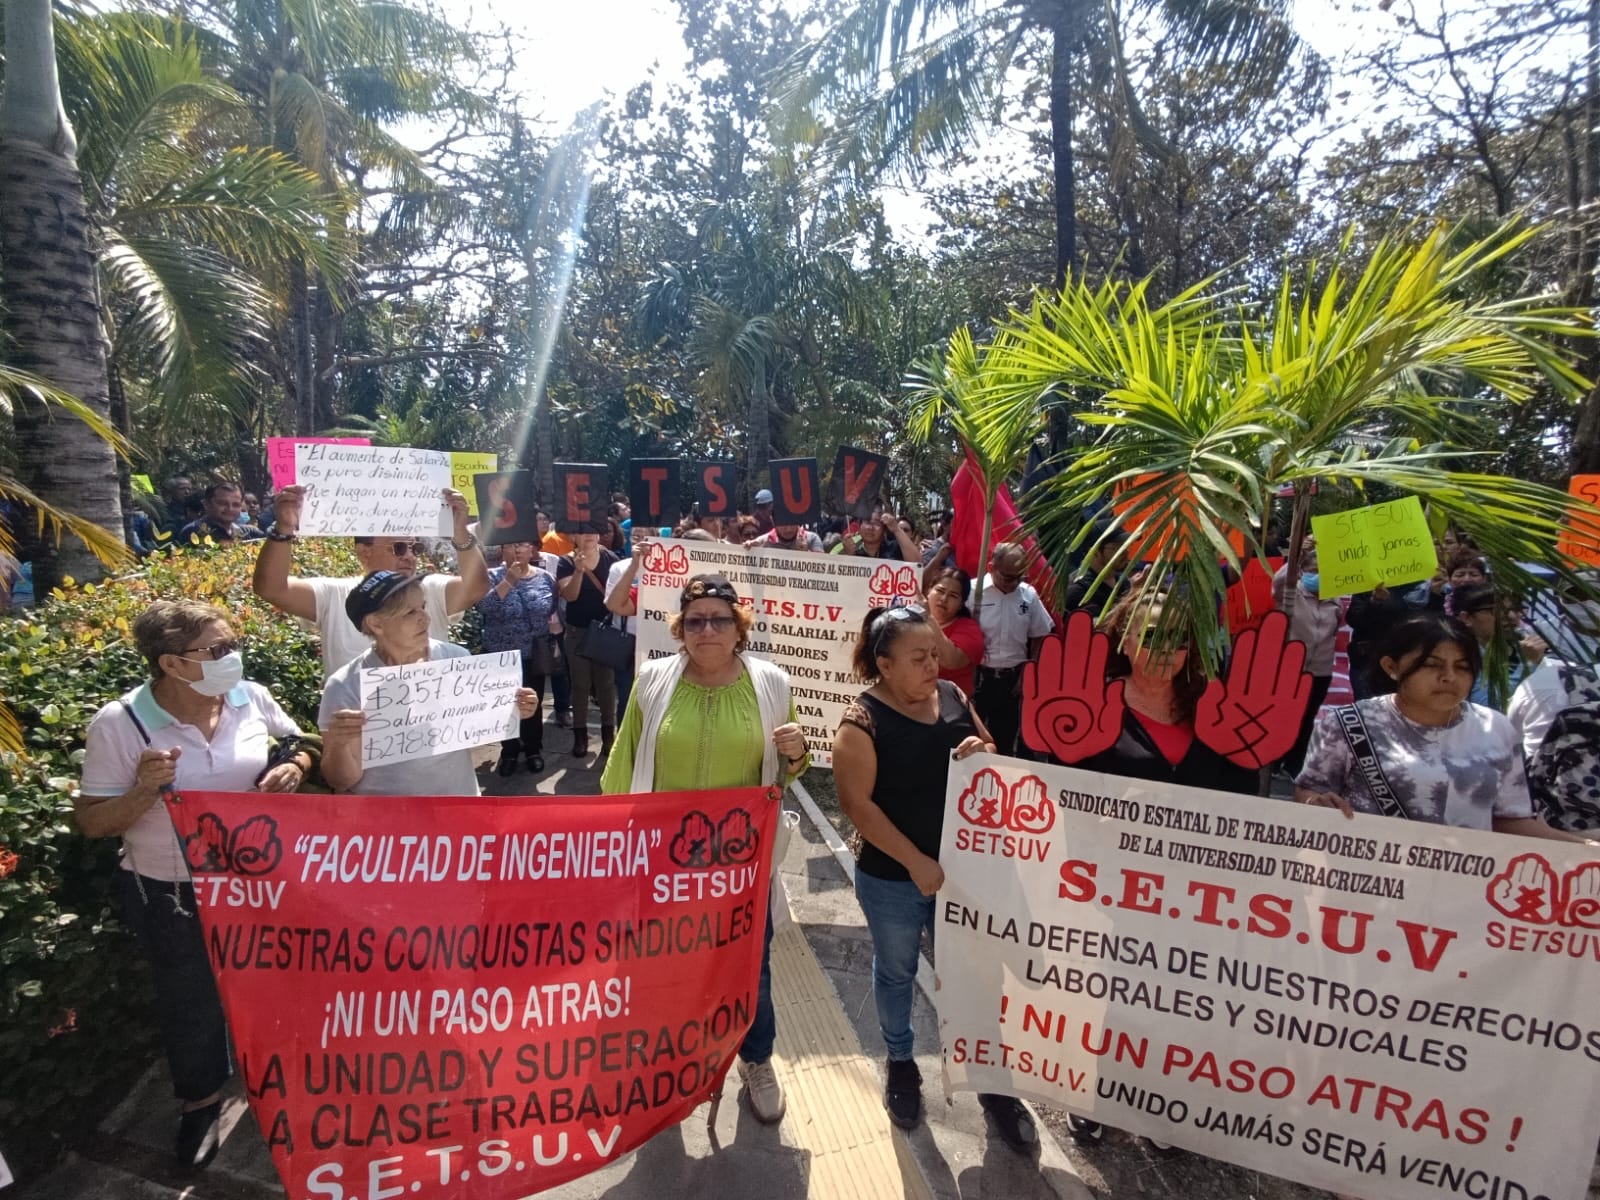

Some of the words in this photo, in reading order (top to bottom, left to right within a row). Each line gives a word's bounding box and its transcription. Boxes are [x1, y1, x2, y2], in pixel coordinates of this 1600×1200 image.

[324, 467, 362, 481] puro
[368, 464, 429, 481] disimulo
[328, 448, 385, 464] aumento
[389, 449, 404, 465] de
[335, 483, 376, 502] hagan
[381, 488, 399, 498] un
[689, 550, 727, 563] SINDICATO
[728, 554, 758, 567] ESTATAL
[759, 557, 769, 569] DE
[771, 557, 826, 574] TRABAJADORES
[827, 563, 837, 575] AL
[837, 564, 872, 578] SERVICIO
[1338, 539, 1370, 563] unido
[729, 571, 739, 582] LA
[739, 573, 787, 588] UNIVERSIDAD
[787, 576, 839, 592] VERACRUZANA
[744, 640, 829, 661] RABAJADORES
[771, 623, 838, 641] SALARIAL
[363, 665, 436, 684] Salario
[824, 670, 833, 681] Y
[362, 707, 438, 733] Salario
[491, 693, 518, 709] 202
[801, 724, 828, 738] ERÁ
[1359, 755, 1396, 810] BIMBA
[955, 828, 1051, 863] SETSUV
[1058, 788, 1140, 823] SINDICATO
[1142, 804, 1211, 836] ESTATAL
[1214, 816, 1240, 839] DE
[1243, 820, 1378, 863] TRABAJADORES
[1378, 842, 1402, 865] AL
[1406, 845, 1497, 879] SERVICIO
[457, 834, 496, 882] DE
[1118, 832, 1143, 851] DE
[1143, 836, 1163, 858] LA
[1167, 841, 1277, 877] UNIVERSIDAD
[1281, 858, 1405, 900] VERACRUZANA
[652, 861, 760, 904] SETSUV
[210, 923, 376, 973] NUESTRAS
[384, 920, 586, 973] CONQUISTAS
[594, 899, 755, 964] SINDICALES
[1057, 859, 1468, 979] S.E.T.S.U.V.
[944, 900, 980, 931] EN
[986, 914, 1020, 944] LA
[1027, 921, 1158, 970] DEFENSA
[1167, 946, 1209, 981] DE
[1217, 956, 1401, 1020] NUESTROS
[320, 990, 365, 1049] ¡NI
[374, 989, 421, 1036] UN
[428, 986, 513, 1035] PASO
[521, 976, 631, 1030] ATRAS!
[1025, 959, 1214, 1022] LABORALES
[1225, 999, 1246, 1028] Y
[1253, 1008, 1468, 1073] SINDICALES
[304, 1049, 466, 1095] UNIDAD
[477, 1047, 503, 1088] Y
[515, 991, 750, 1085] SUPERACIÓN
[1022, 1003, 1066, 1044] NI
[1081, 1022, 1149, 1069] UN
[1162, 1043, 1296, 1100] PASO
[311, 1101, 452, 1150] CLASE
[464, 1046, 727, 1133] TRABAJADOR
[953, 1037, 1087, 1093] S.E.T.S.U.V.
[1096, 1077, 1189, 1124] UNIDO
[1194, 1106, 1295, 1147] JAMÁS
[1301, 1127, 1387, 1176] SERÁ
[1400, 1154, 1552, 1200] VENCID
